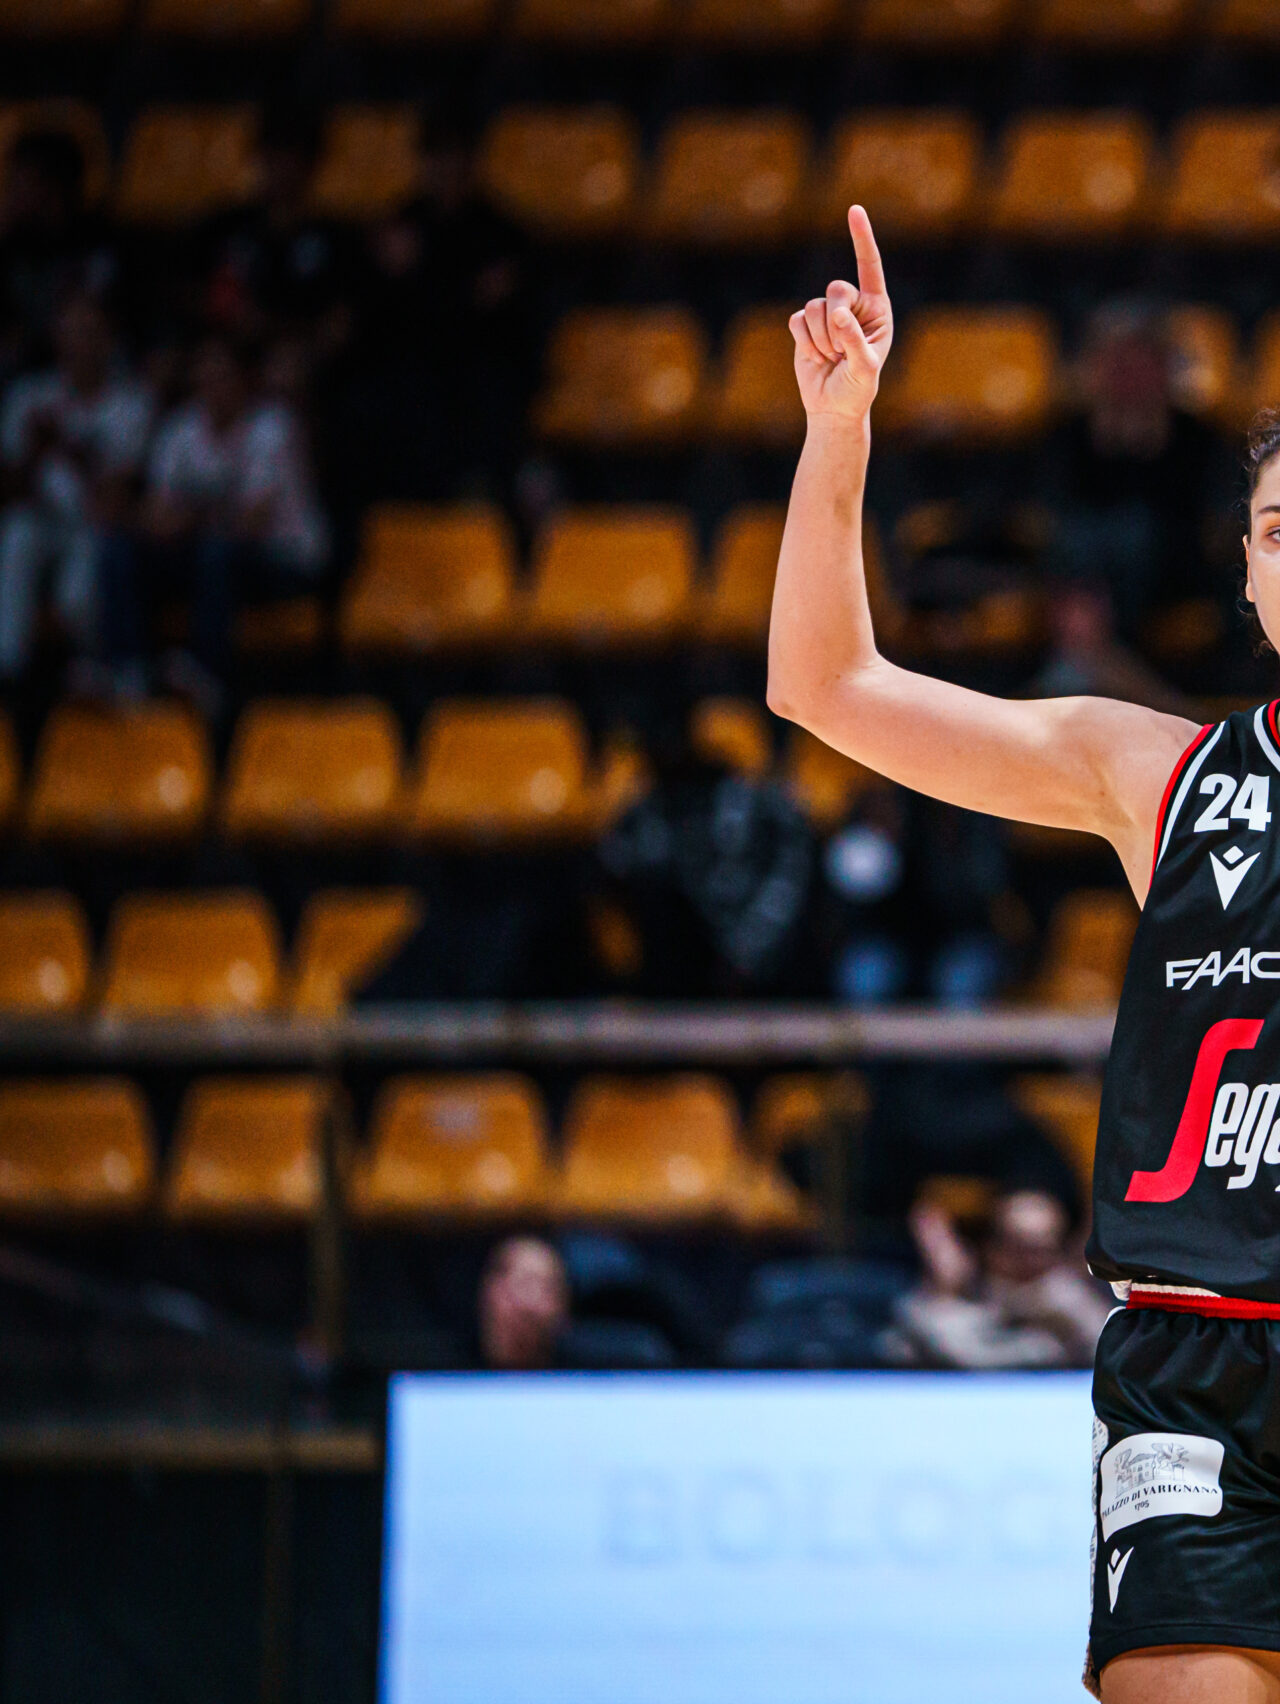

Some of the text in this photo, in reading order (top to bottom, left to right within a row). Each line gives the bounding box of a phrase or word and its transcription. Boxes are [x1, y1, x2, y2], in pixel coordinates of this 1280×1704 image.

[1193, 773, 1272, 833] 24
[602, 1464, 1068, 1568] BOLOG
[1143, 1484, 1218, 1496] VARIGNANA
